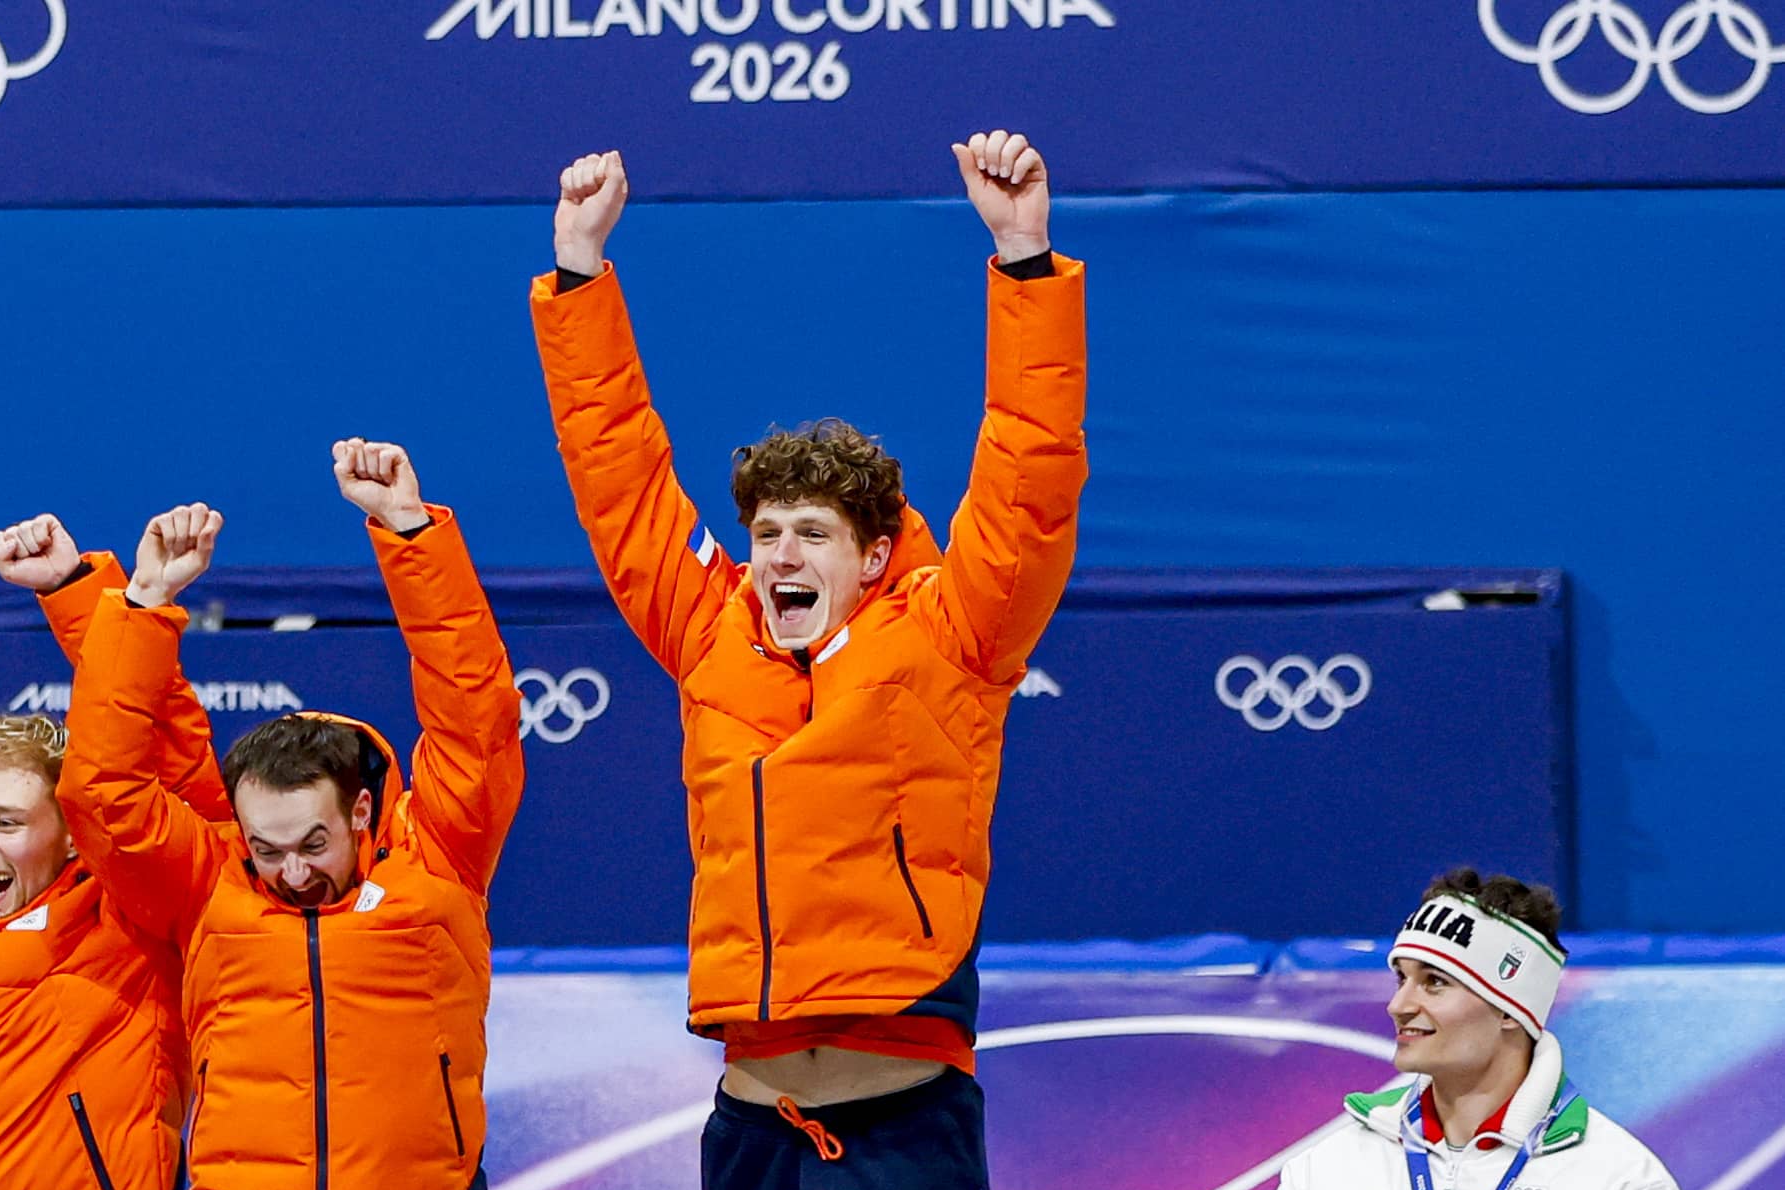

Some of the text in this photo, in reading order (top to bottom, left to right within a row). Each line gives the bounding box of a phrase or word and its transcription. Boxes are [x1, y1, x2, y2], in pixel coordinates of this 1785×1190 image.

[425, 0, 761, 40] MILANO
[690, 42, 850, 103] 2026
[193, 681, 304, 712] RTINA
